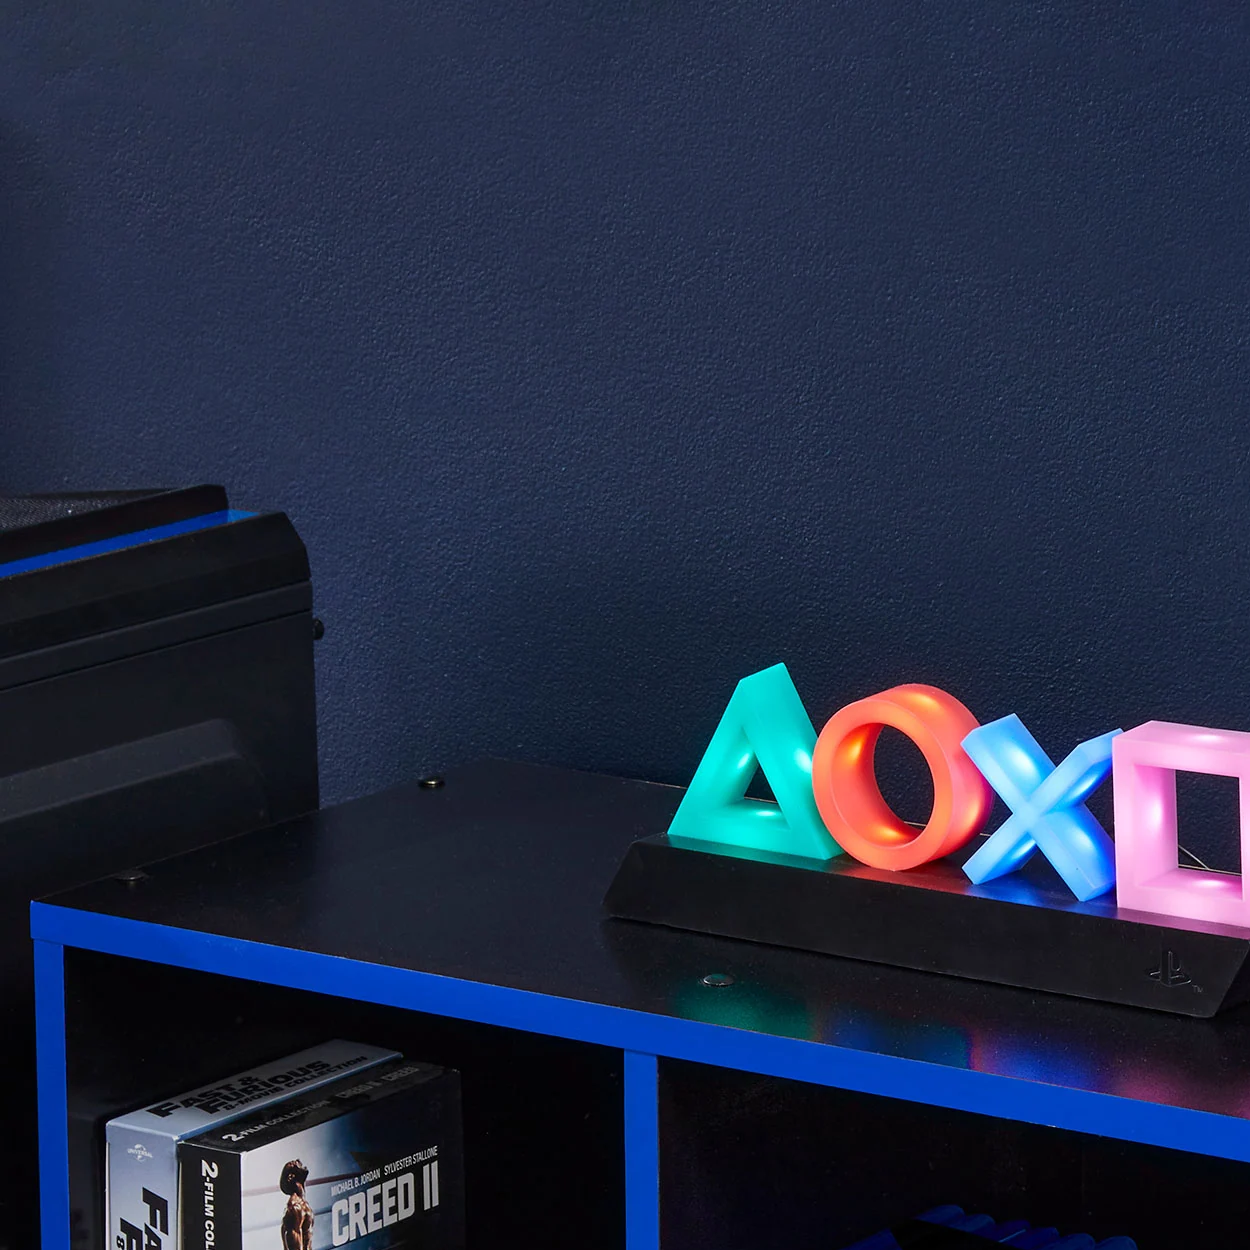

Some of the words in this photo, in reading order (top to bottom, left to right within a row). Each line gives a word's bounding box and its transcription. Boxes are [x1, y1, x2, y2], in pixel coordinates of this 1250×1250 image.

[195, 1060, 330, 1114] FURIOUS
[284, 1056, 367, 1090] COLLECTION
[146, 1083, 235, 1118] FAST
[265, 1099, 331, 1126] COLLECTION
[201, 1160, 219, 1217] 2-FILM
[331, 1179, 354, 1197] MICHAEL
[360, 1168, 381, 1185] JORDAN
[384, 1156, 413, 1176] SYLVESTER
[413, 1145, 438, 1164] STALLONE
[331, 1172, 415, 1247] CREED
[423, 1160, 439, 1211] II
